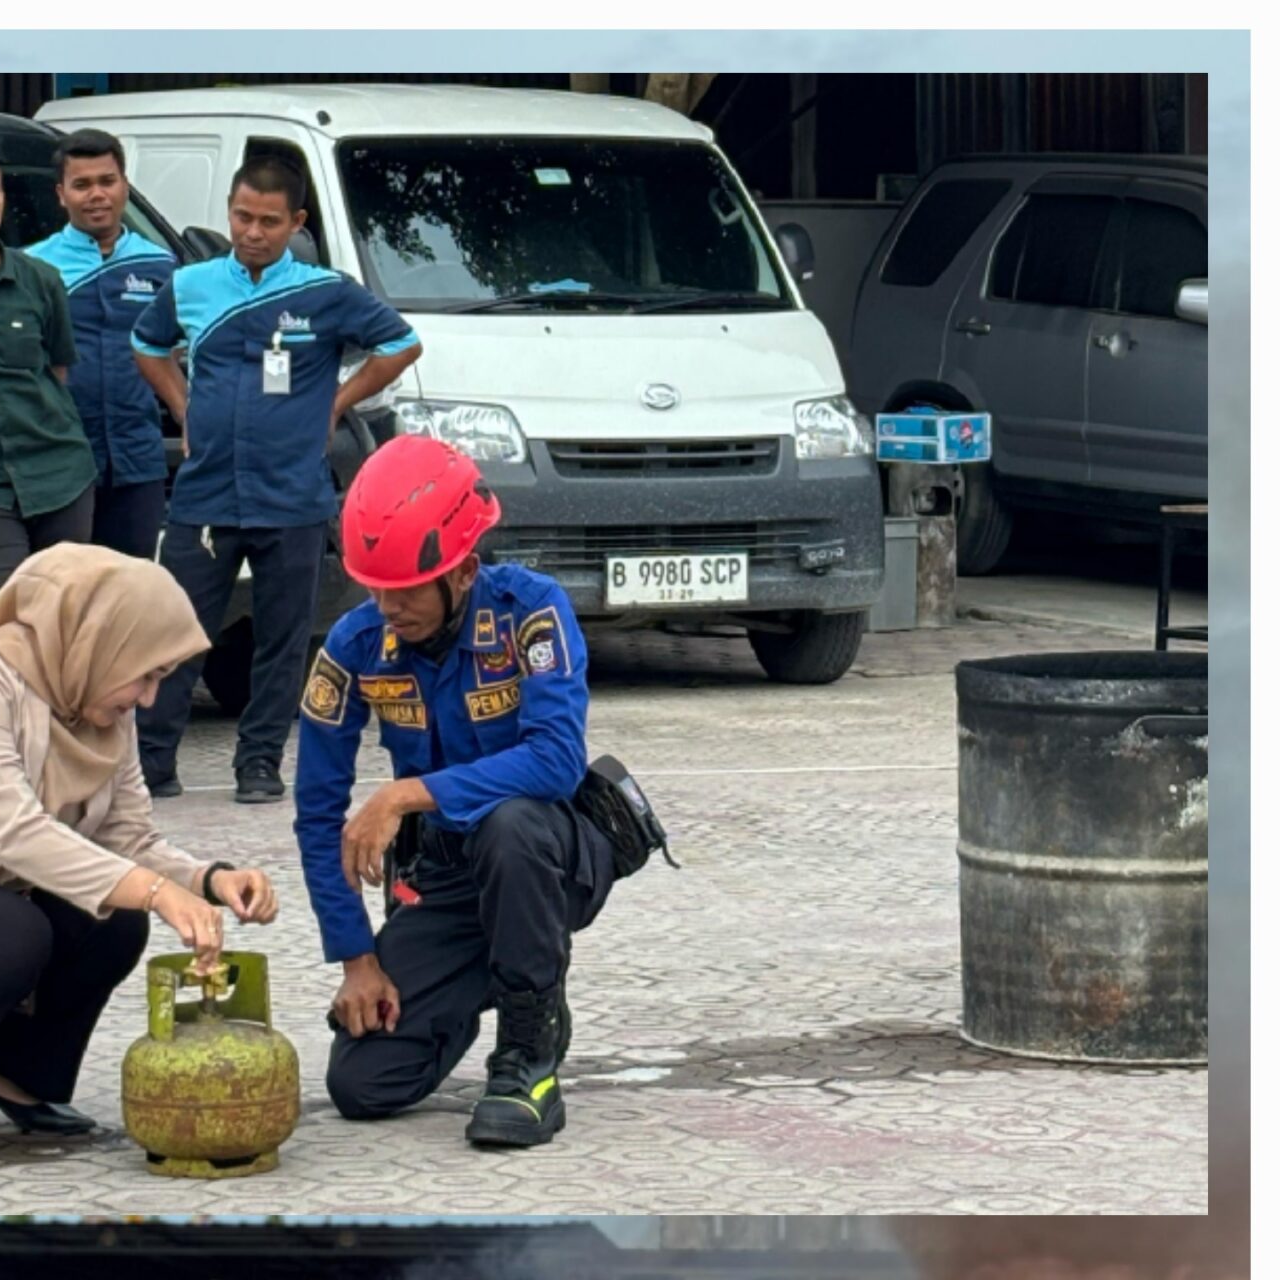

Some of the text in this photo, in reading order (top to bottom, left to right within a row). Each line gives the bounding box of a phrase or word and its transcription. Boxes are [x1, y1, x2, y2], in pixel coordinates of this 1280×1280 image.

[612, 557, 741, 587] B 9980 SCP
